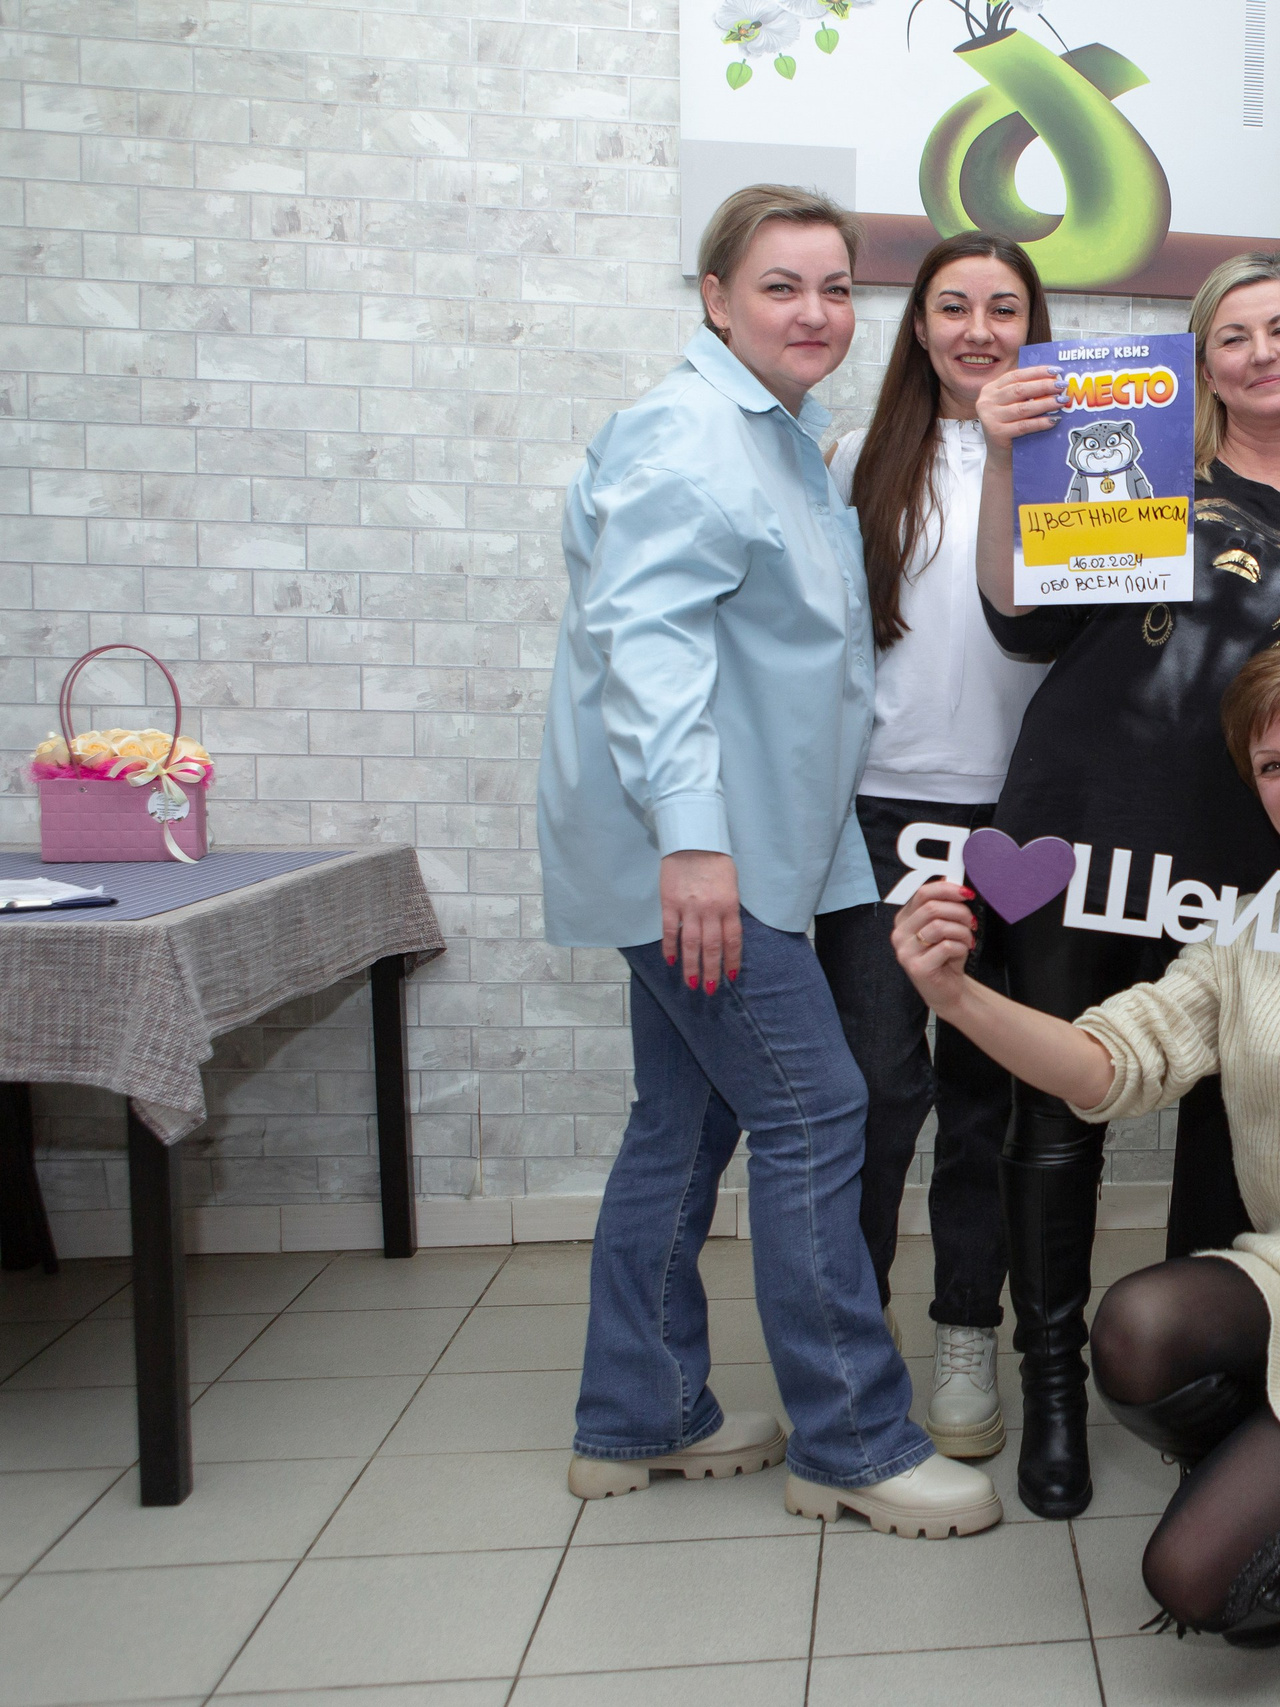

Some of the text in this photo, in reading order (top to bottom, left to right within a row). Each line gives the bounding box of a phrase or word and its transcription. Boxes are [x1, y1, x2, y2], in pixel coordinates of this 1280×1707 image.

[1058, 345, 1150, 361] ШЕЙКЕР КВИЗ
[1064, 370, 1175, 408] МЕСТО
[1073, 553, 1143, 570] 16.02.2024
[1040, 578, 1069, 595] ОБО
[1075, 575, 1119, 592] ВСЕМ
[883, 821, 971, 905] Я
